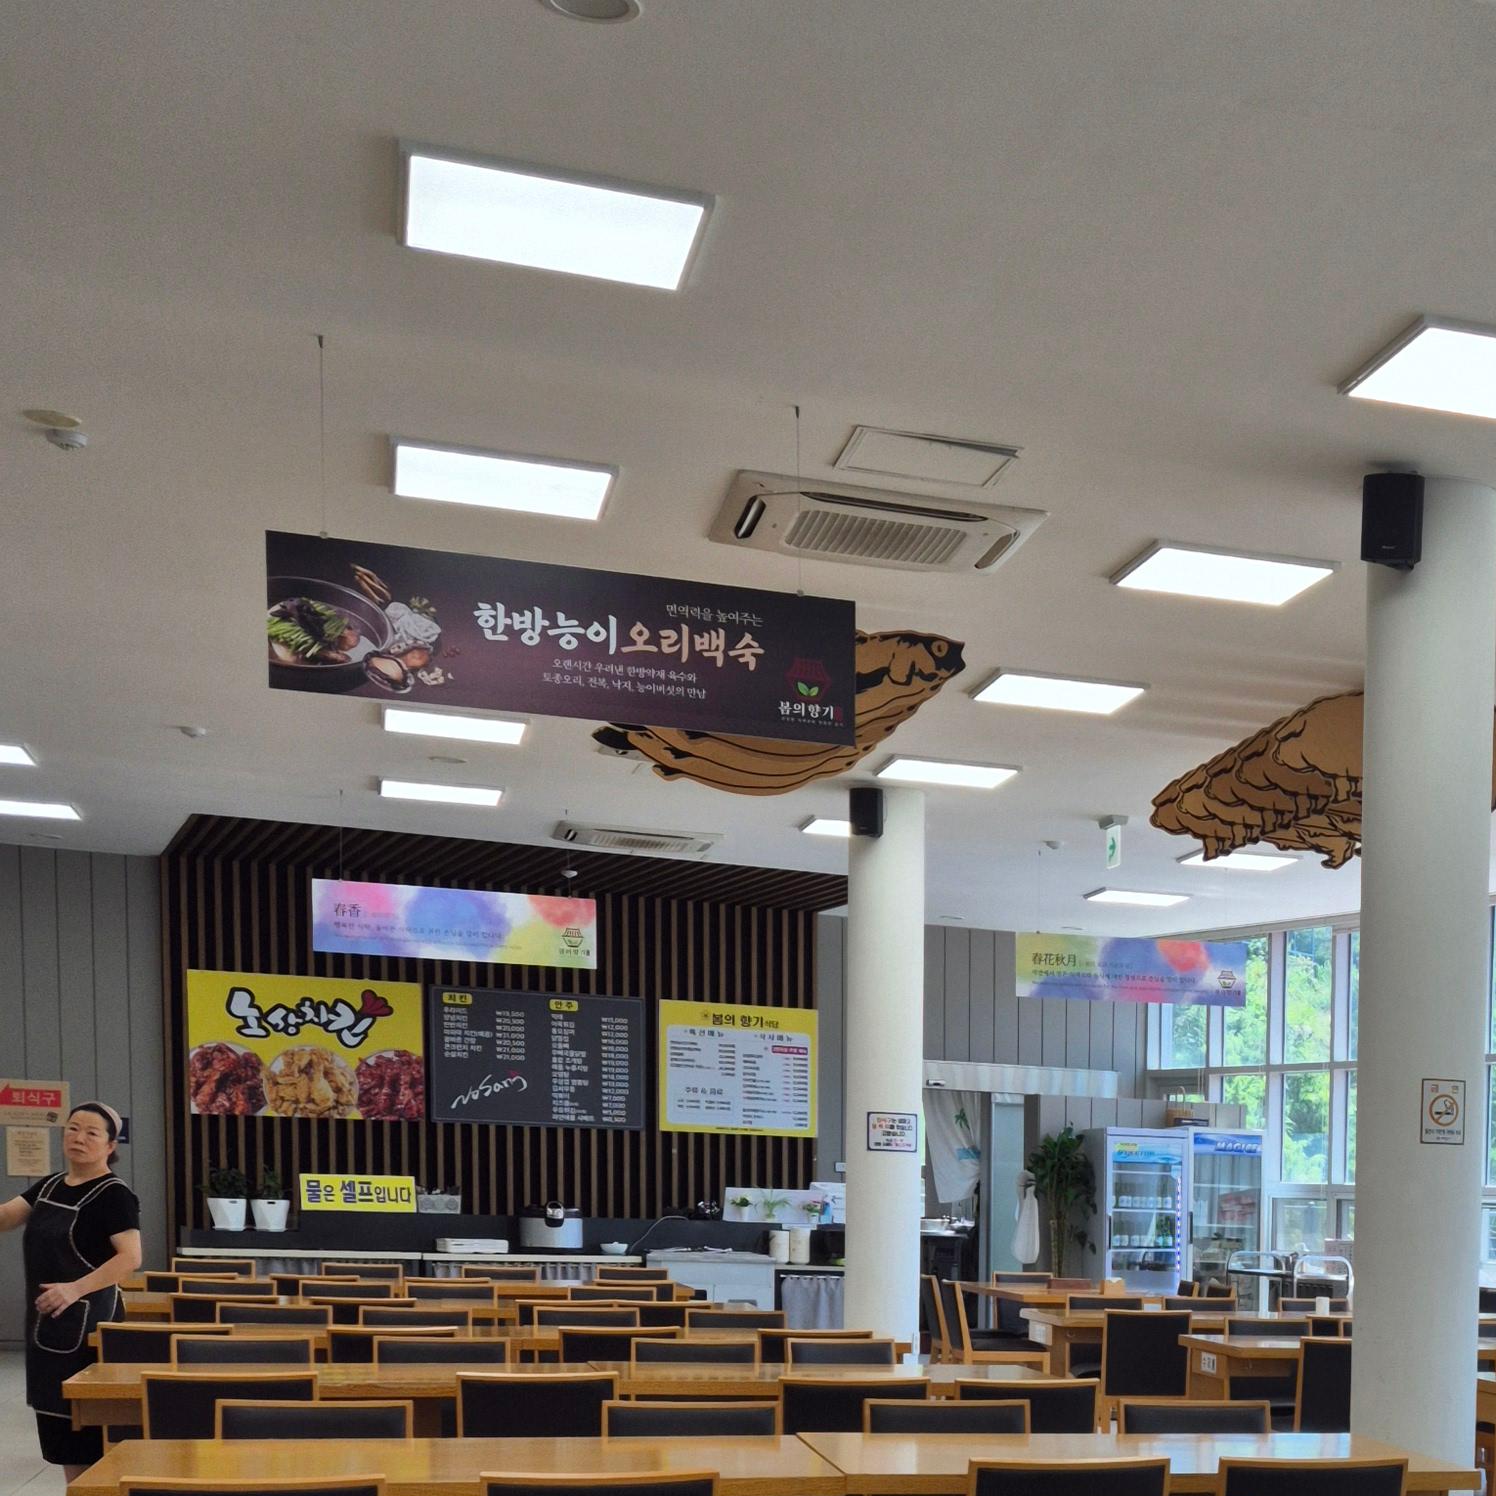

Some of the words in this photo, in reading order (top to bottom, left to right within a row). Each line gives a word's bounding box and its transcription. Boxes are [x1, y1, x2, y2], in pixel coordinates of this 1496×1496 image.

[1032, 952, 1077, 967] 春花秋月
[712, 1013, 735, 1026] 봄의
[740, 1015, 764, 1028] 향기
[12, 1090, 56, 1106] 퇴식구
[306, 1180, 335, 1203] 물은
[340, 1180, 411, 1203] 셀프입니다
